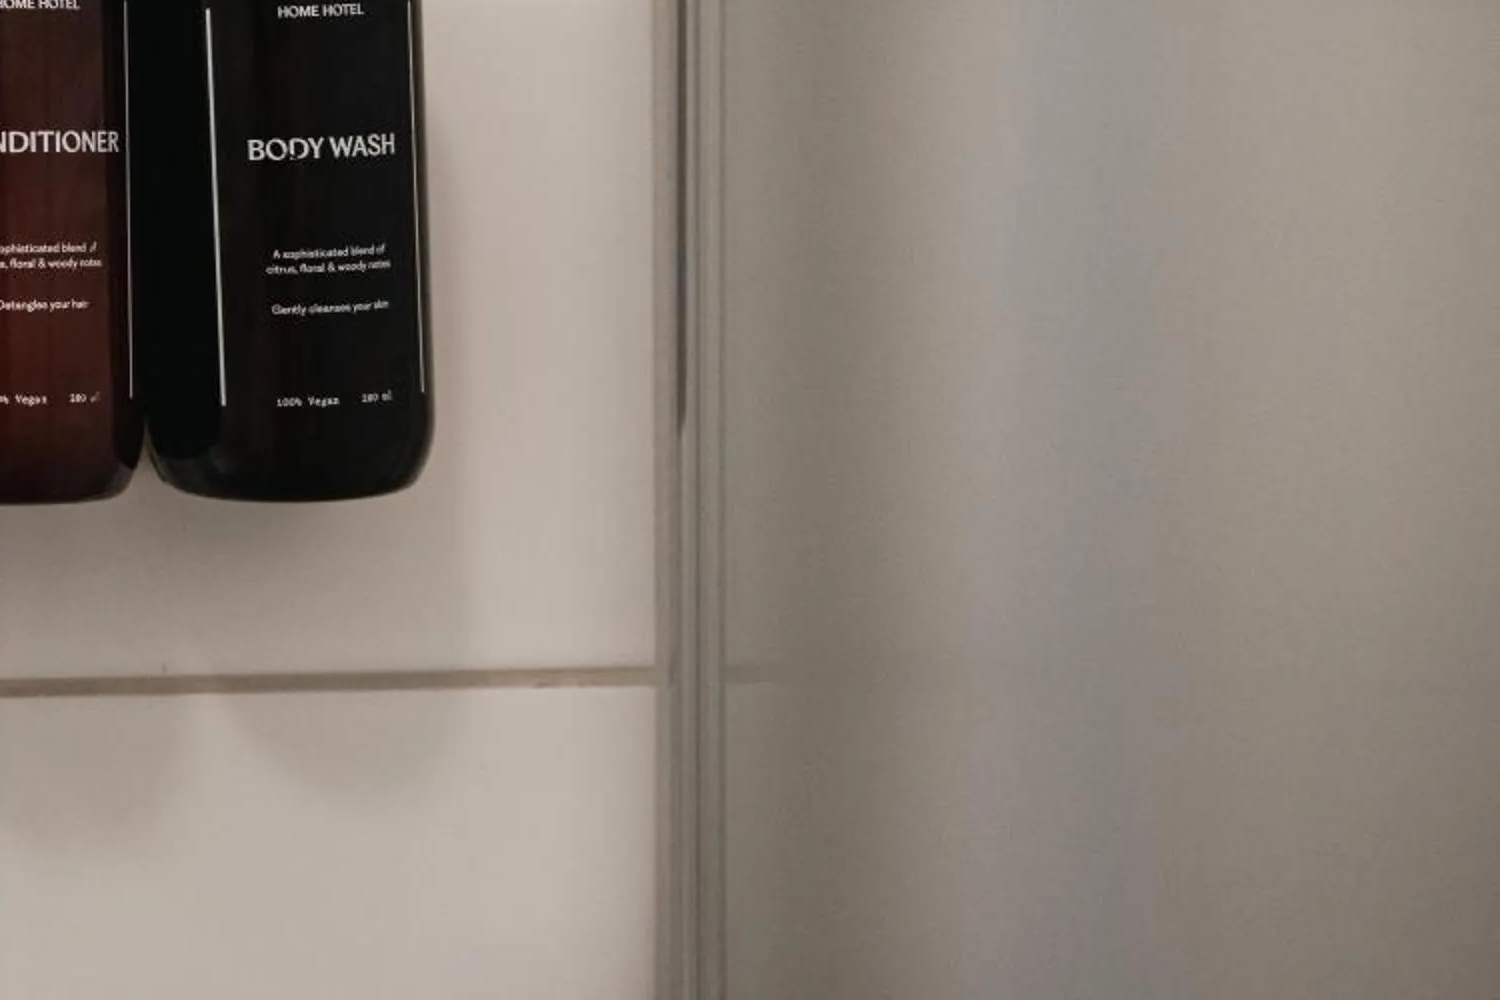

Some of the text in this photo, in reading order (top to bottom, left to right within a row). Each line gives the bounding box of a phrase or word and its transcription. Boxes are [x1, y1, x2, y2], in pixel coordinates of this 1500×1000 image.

[277, 3, 364, 18] HOME HOTEL
[247, 133, 395, 161] BODY WASH
[61, 242, 87, 253] blend
[273, 249, 281, 259] A
[283, 246, 349, 260] sophisticated
[350, 244, 375, 256] blend
[9, 258, 36, 269] floral
[38, 257, 46, 269] &
[48, 258, 77, 270] woody
[300, 262, 325, 273] floral
[327, 261, 336, 272] &
[337, 259, 367, 273] woody
[49, 301, 70, 313] your
[271, 303, 306, 316] Gently
[352, 302, 372, 314] your
[373, 299, 389, 309] skin
[277, 396, 340, 408] 100% Vegan
